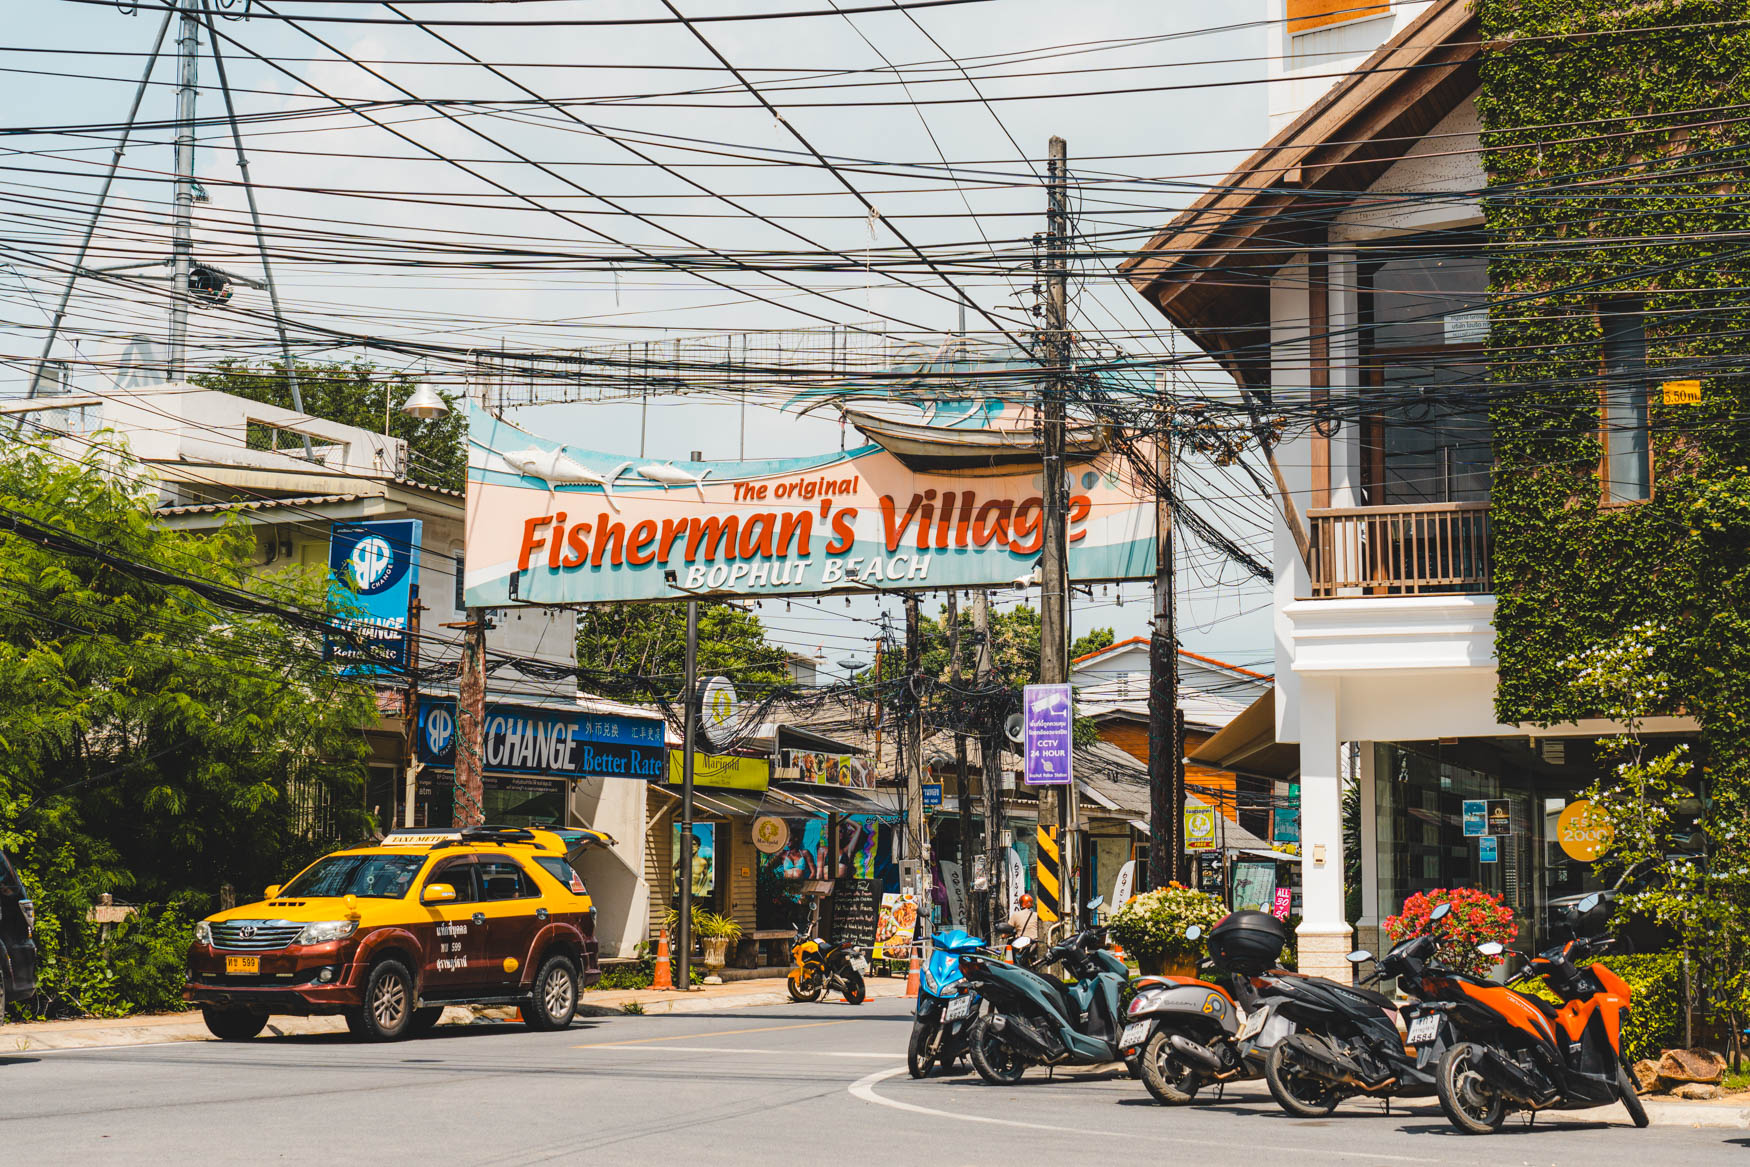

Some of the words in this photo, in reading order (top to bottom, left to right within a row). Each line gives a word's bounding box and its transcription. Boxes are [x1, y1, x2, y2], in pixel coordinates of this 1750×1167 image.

[733, 482, 772, 501] The
[774, 475, 859, 499] original
[517, 498, 858, 571] Fisherman's
[879, 489, 1092, 555] Village
[371, 564, 394, 590] CHANGE
[684, 559, 813, 589] BOPHUT
[821, 554, 932, 584] BEACH
[584, 721, 620, 739] 外币兑换
[483, 716, 579, 771] CHANGE
[1037, 739, 1059, 748] CCTV
[583, 746, 629, 773] Better
[630, 749, 662, 776] Rate
[703, 755, 740, 774] Marigold
[1563, 829, 1607, 842] 2000
[1275, 897, 1290, 906] 30
[1276, 888, 1289, 898] ALL
[451, 942, 462, 952] 599
[242, 958, 256, 967] 599
